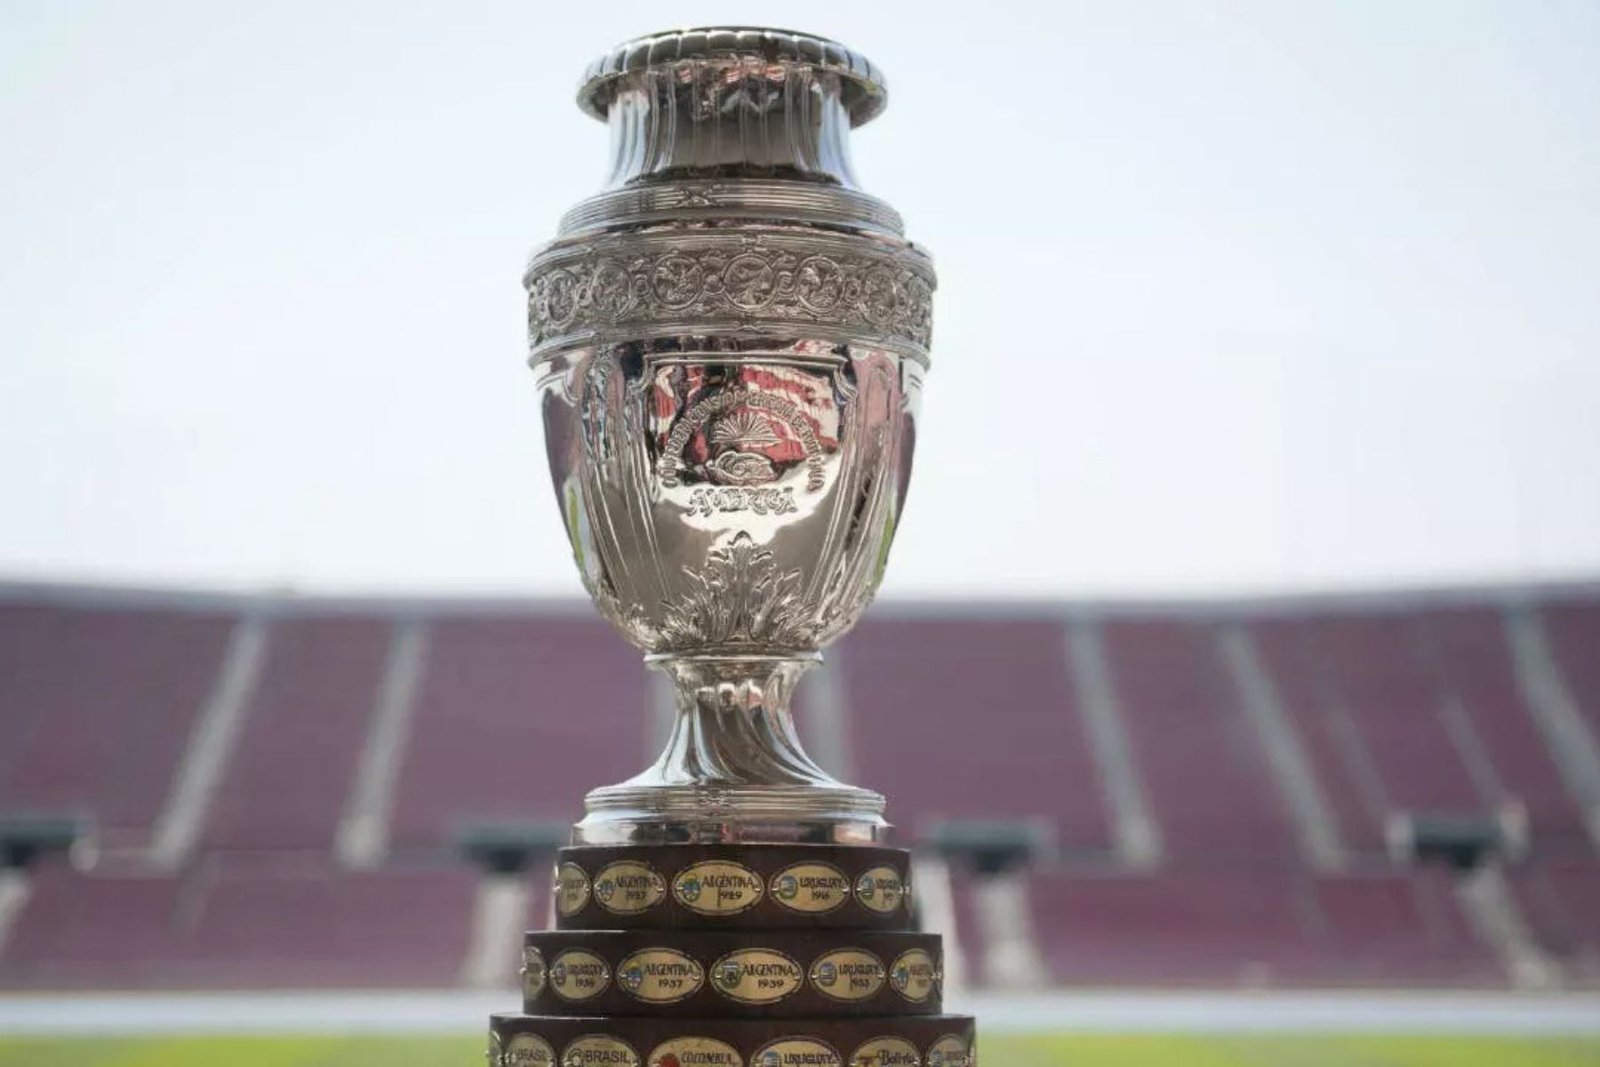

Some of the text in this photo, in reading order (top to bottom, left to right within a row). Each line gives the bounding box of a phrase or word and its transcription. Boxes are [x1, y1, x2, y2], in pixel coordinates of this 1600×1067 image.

[702, 874, 755, 889] ARGENTINA
[742, 963, 794, 977] ARGENTINA
[585, 1050, 628, 1063] BRASIL
